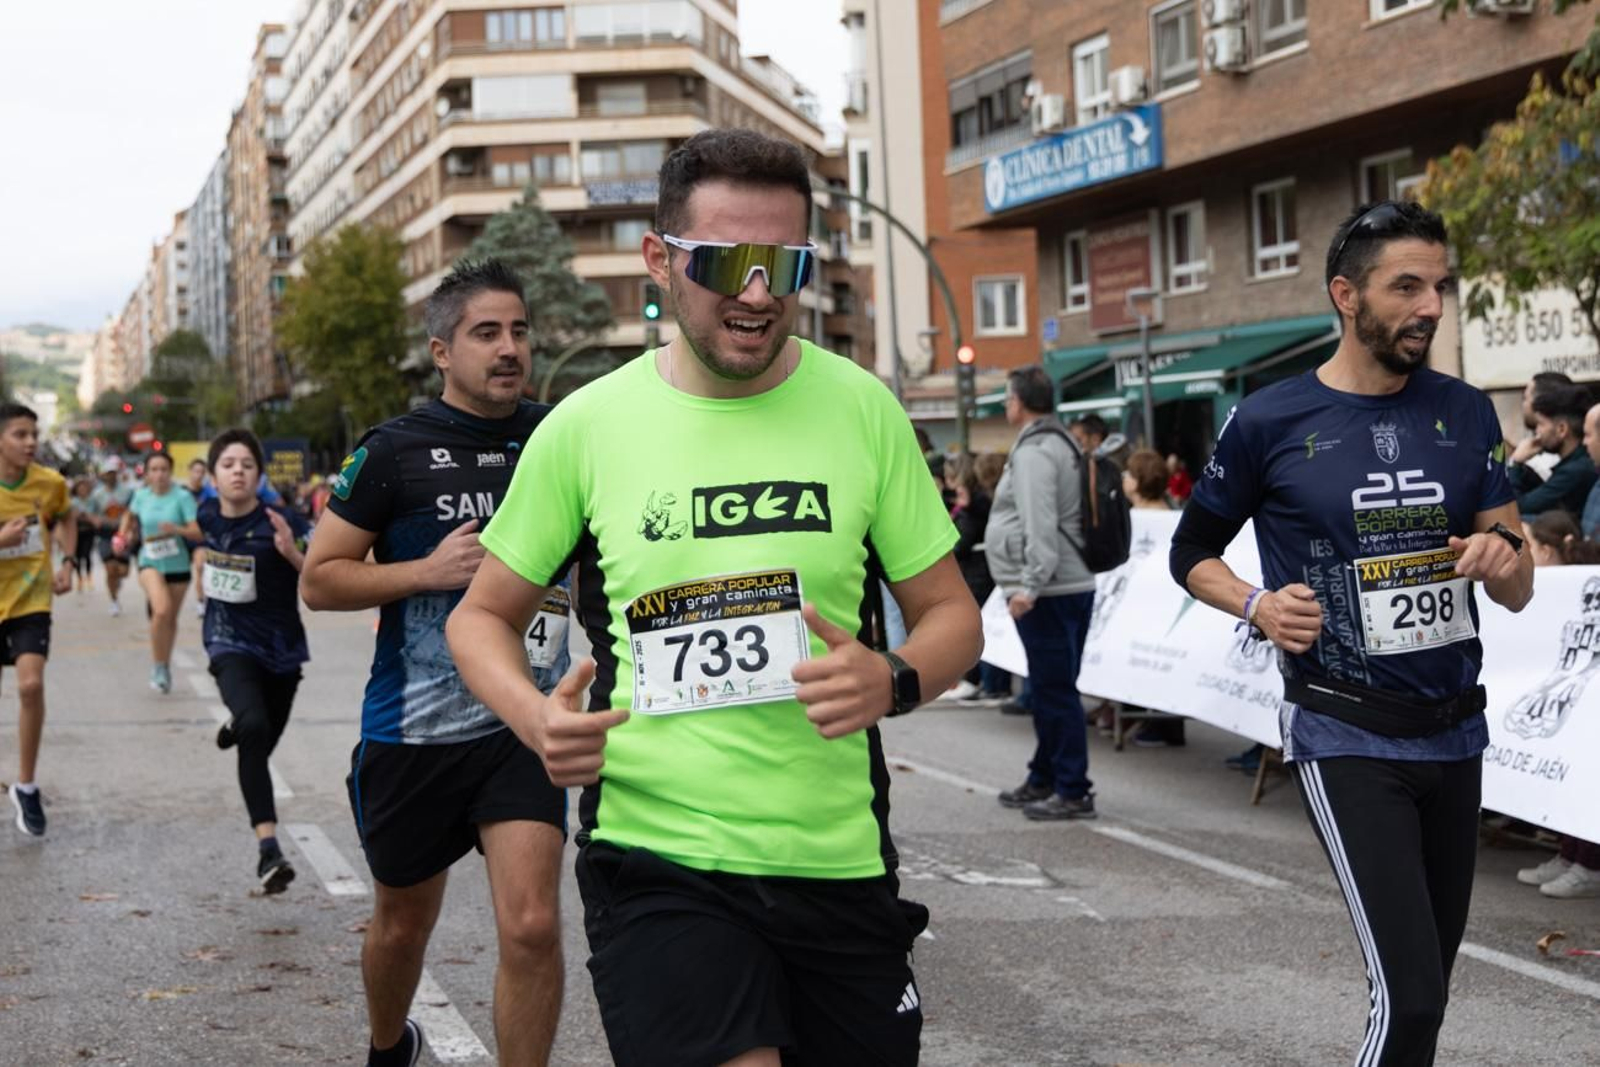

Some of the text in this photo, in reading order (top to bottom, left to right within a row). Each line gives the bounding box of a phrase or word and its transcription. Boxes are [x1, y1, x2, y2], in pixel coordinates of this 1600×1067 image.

[1063, 121, 1128, 168] DENTAL
[1483, 315, 1518, 347] 958
[1525, 309, 1563, 342] 650
[1352, 469, 1446, 510] 25
[435, 492, 494, 521] SAN
[1353, 505, 1446, 523] CARRERA
[1356, 517, 1448, 535] POPULAR
[1370, 533, 1394, 544] gran
[1309, 539, 1334, 558] IES
[1362, 562, 1390, 581] XXV
[1392, 555, 1434, 568] CARRERA
[1405, 565, 1429, 577] gran
[631, 575, 791, 618] XXV CARRERA POPULAR
[670, 584, 793, 611] y gran caminata
[1390, 587, 1454, 630] 298
[670, 614, 682, 625] LA
[708, 608, 721, 620] LA
[528, 616, 547, 648] 4
[664, 624, 769, 683] 733
[1229, 681, 1250, 700] DE
[1512, 752, 1533, 773] DE
[1531, 755, 1570, 782] JAÉN
